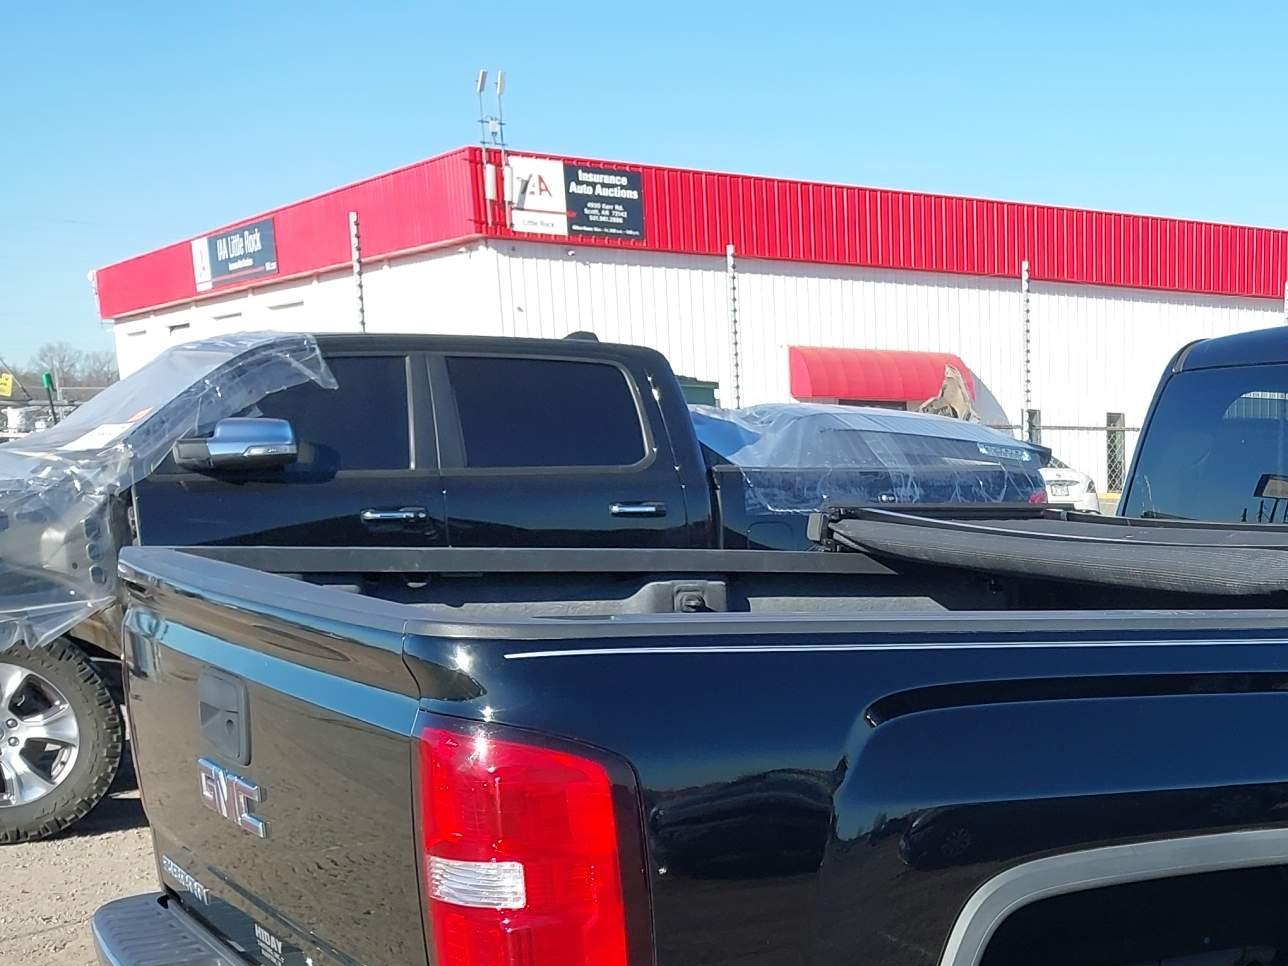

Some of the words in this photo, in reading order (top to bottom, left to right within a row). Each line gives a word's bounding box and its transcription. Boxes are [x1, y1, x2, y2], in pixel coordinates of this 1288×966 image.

[578, 169, 628, 186] Insurance
[569, 181, 594, 195] Auto
[595, 184, 639, 199] Auctions
[198, 758, 265, 839] GMC
[254, 923, 283, 954] HIDAY
